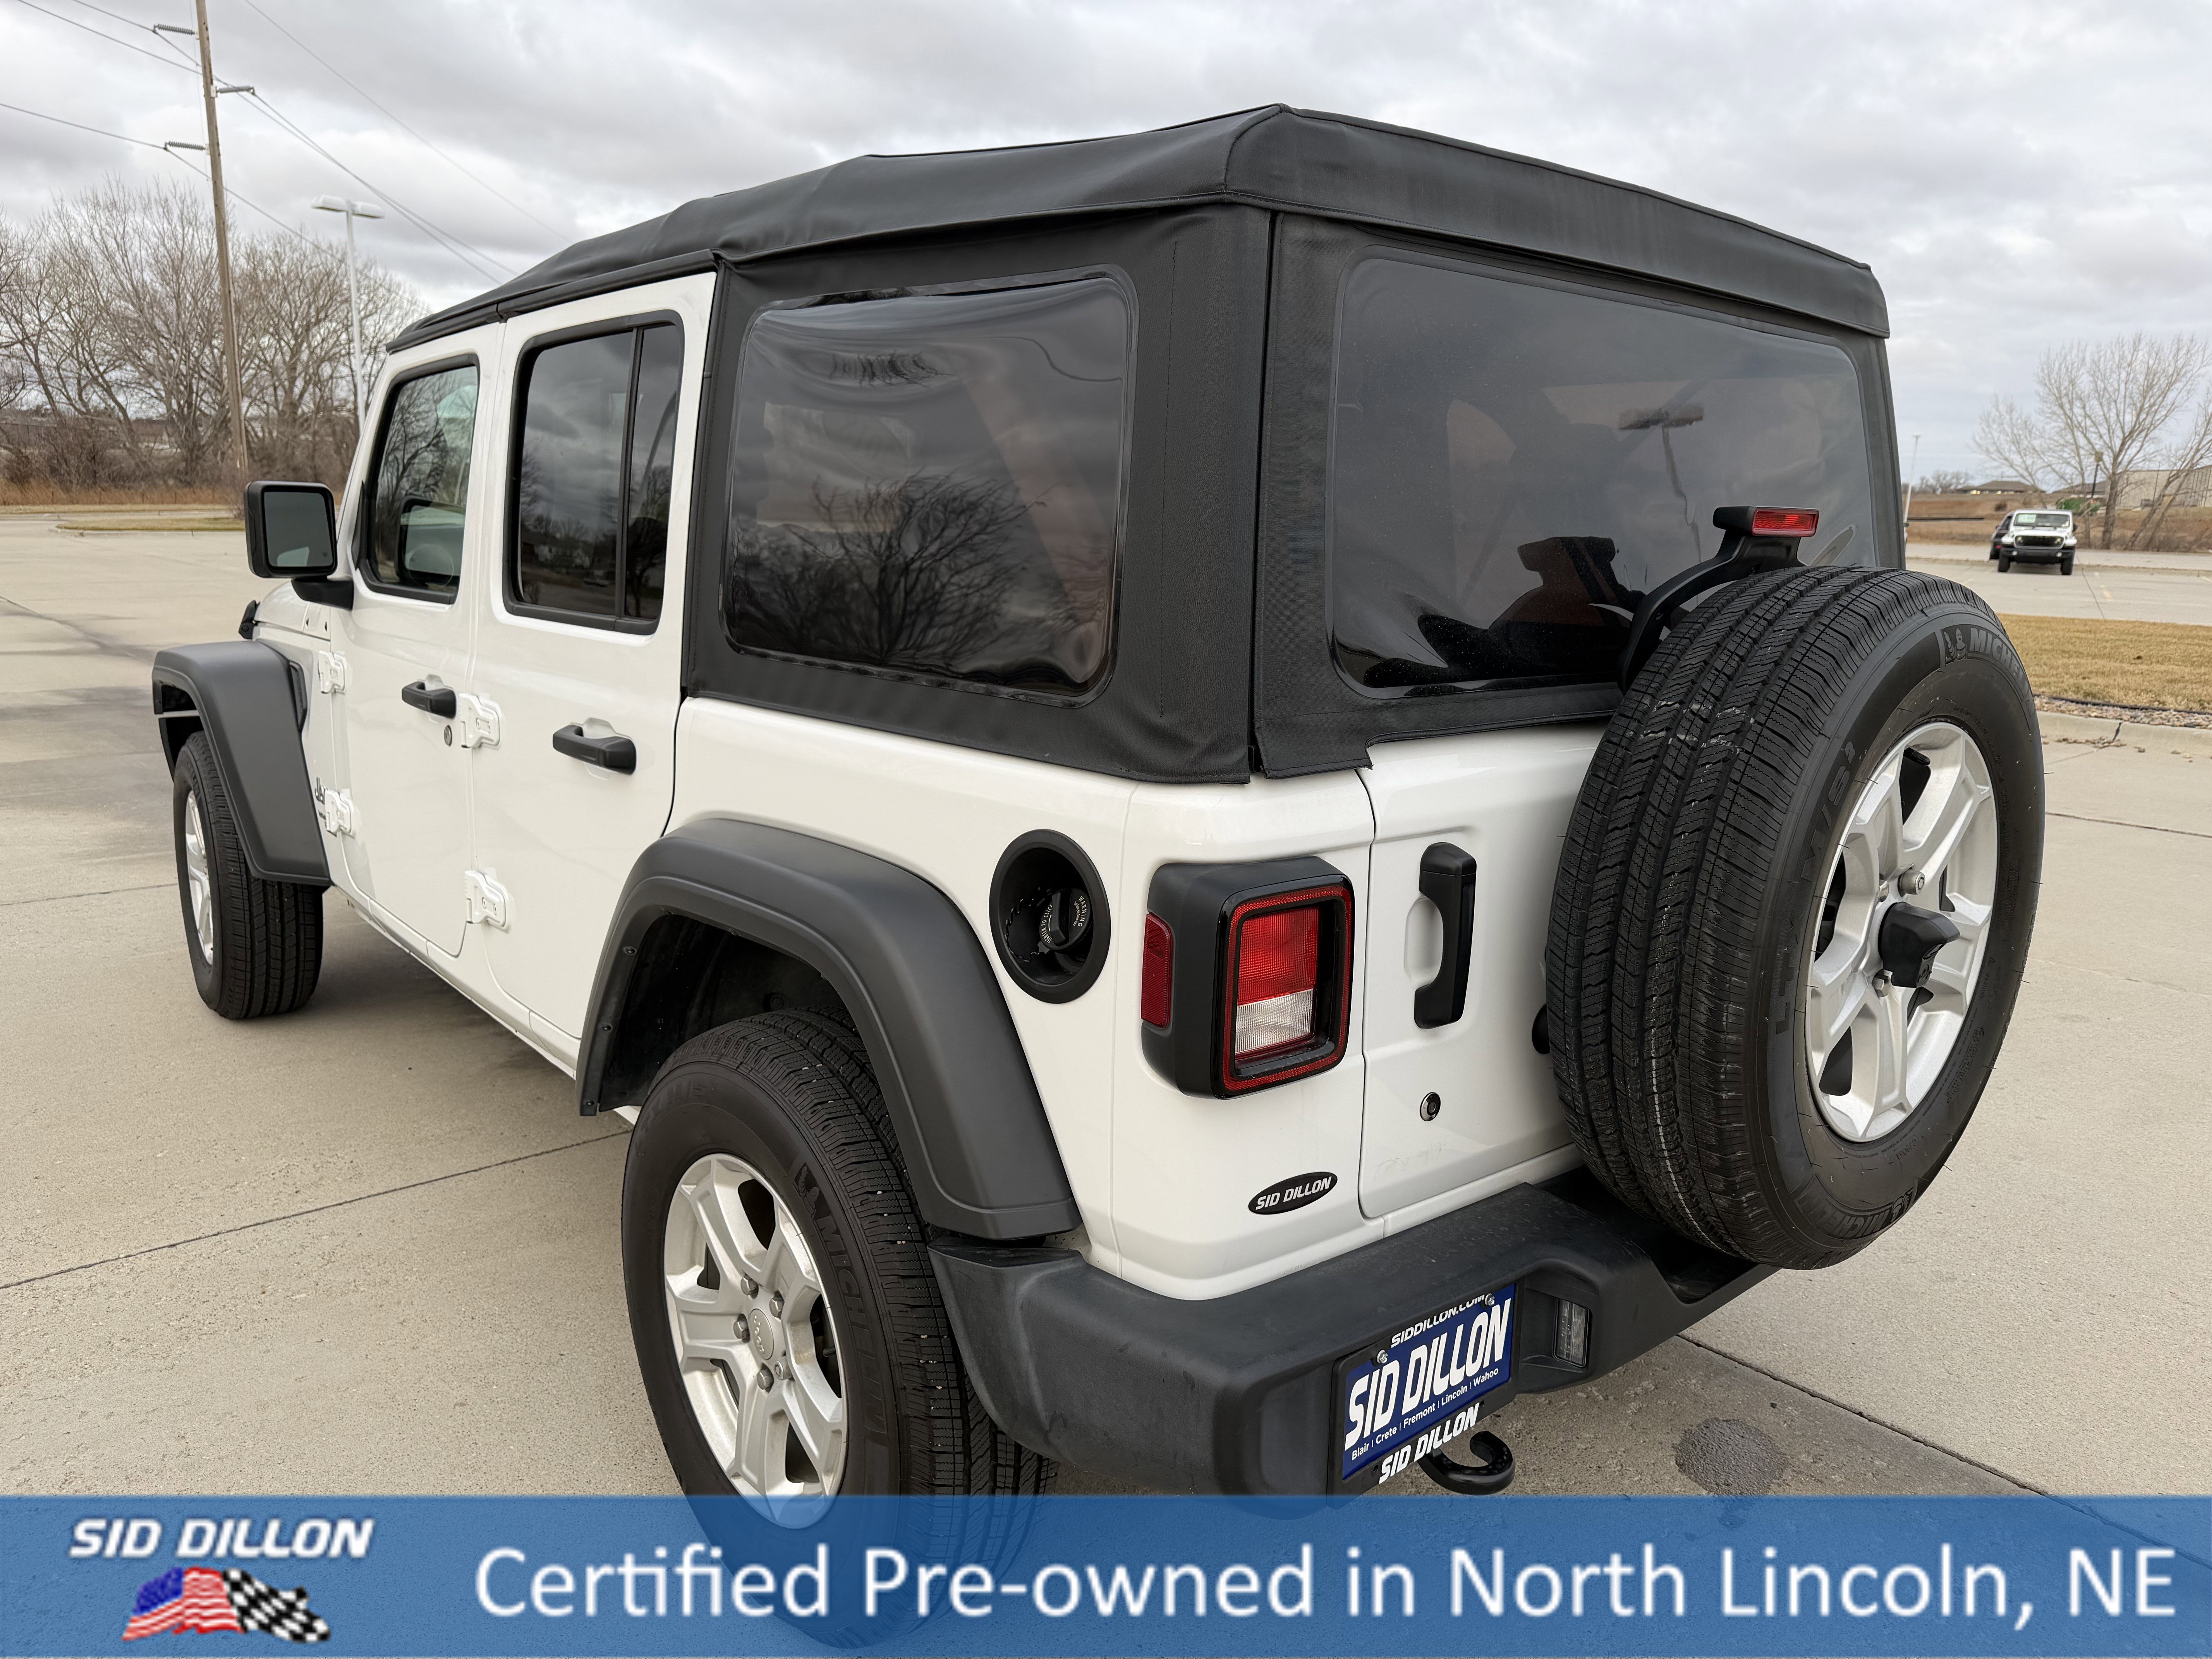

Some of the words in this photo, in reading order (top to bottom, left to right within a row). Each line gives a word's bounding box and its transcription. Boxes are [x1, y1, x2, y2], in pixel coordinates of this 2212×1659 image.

[1078, 895, 1087, 927] WARNING
[1255, 1192, 1280, 1210] SID
[1283, 1176, 1331, 1202] DILLON
[815, 1215, 888, 1435] MICHELIN
[1345, 1359, 1400, 1451] SID
[1402, 1298, 1511, 1415] DILLON
[1352, 1441, 1370, 1460] Blair
[1376, 1427, 1397, 1445] Crete
[1404, 1403, 1436, 1429] Fremont
[1441, 1385, 1468, 1407] Lincoln
[1473, 1368, 1499, 1387] Wahoo
[1379, 1444, 1411, 1484] SID
[1414, 1403, 1480, 1462] DILLON
